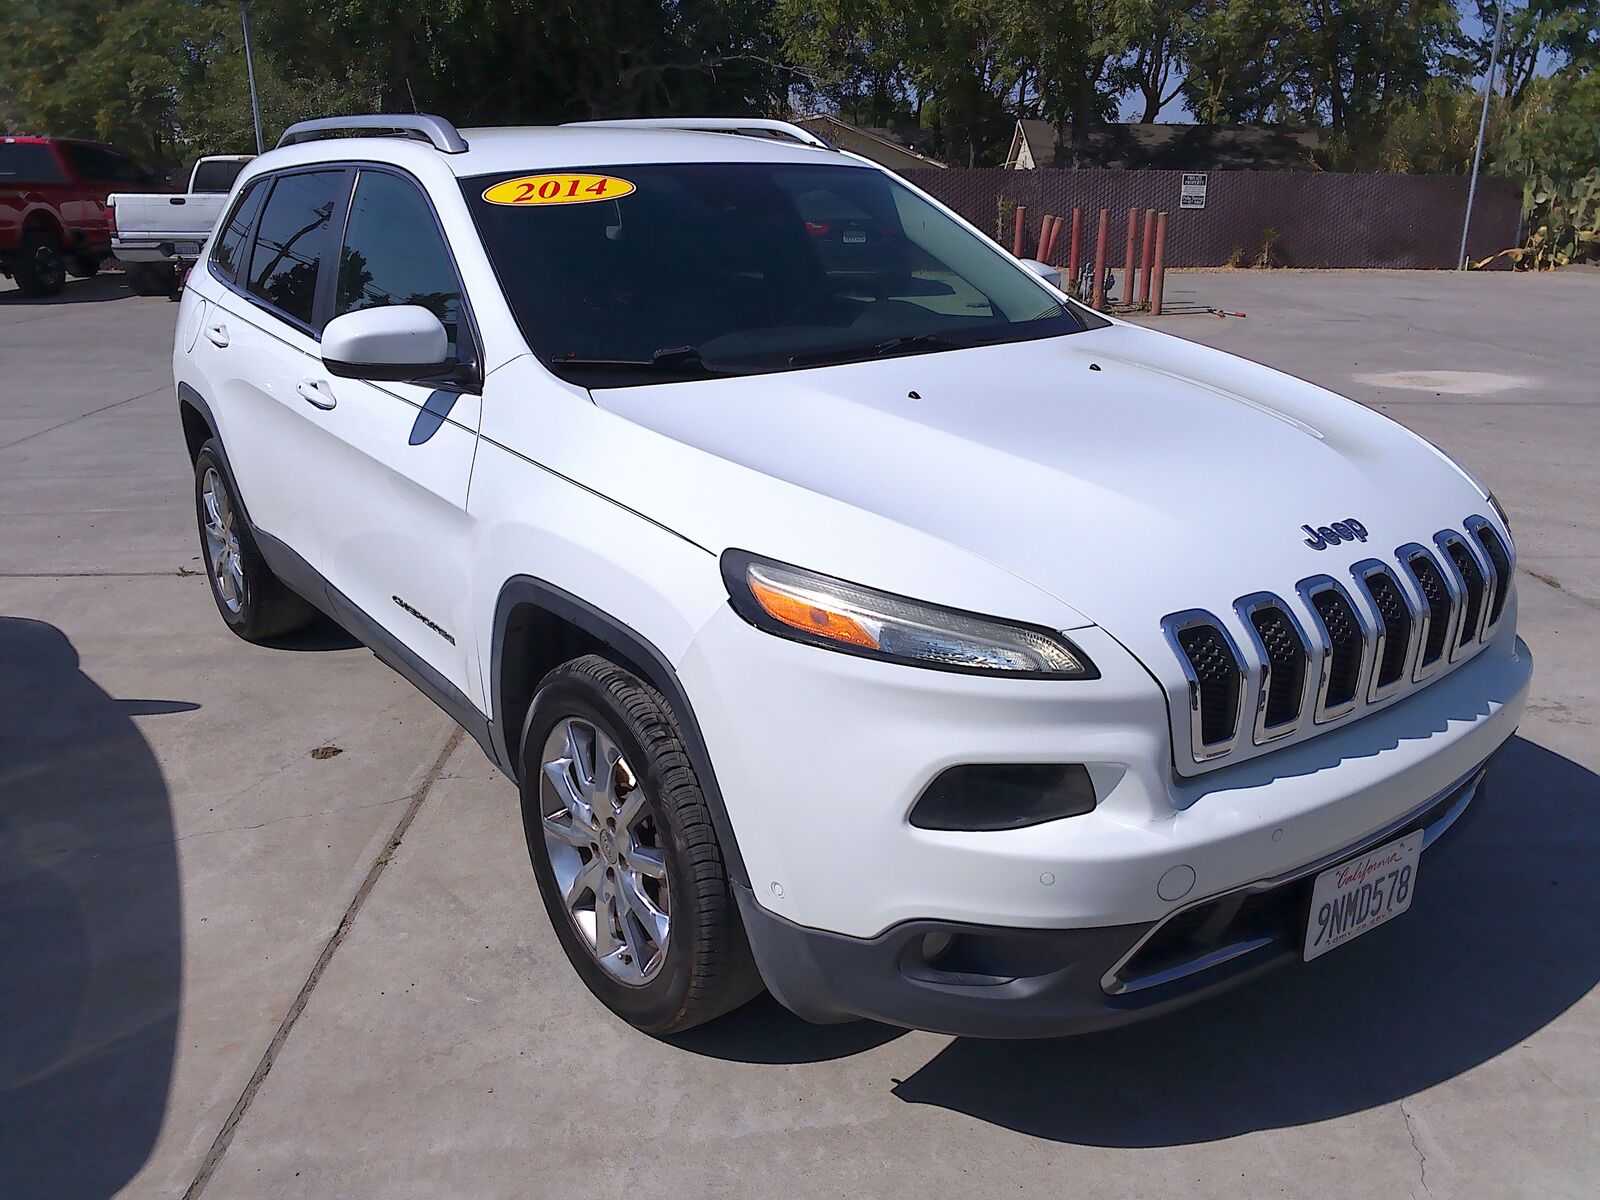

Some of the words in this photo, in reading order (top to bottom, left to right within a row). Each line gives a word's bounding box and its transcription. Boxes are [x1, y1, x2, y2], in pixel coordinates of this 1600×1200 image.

[512, 178, 608, 203] 2014
[1300, 517, 1369, 551] Jeep
[1336, 853, 1403, 889] California
[1313, 865, 1412, 947] 9NMD578
